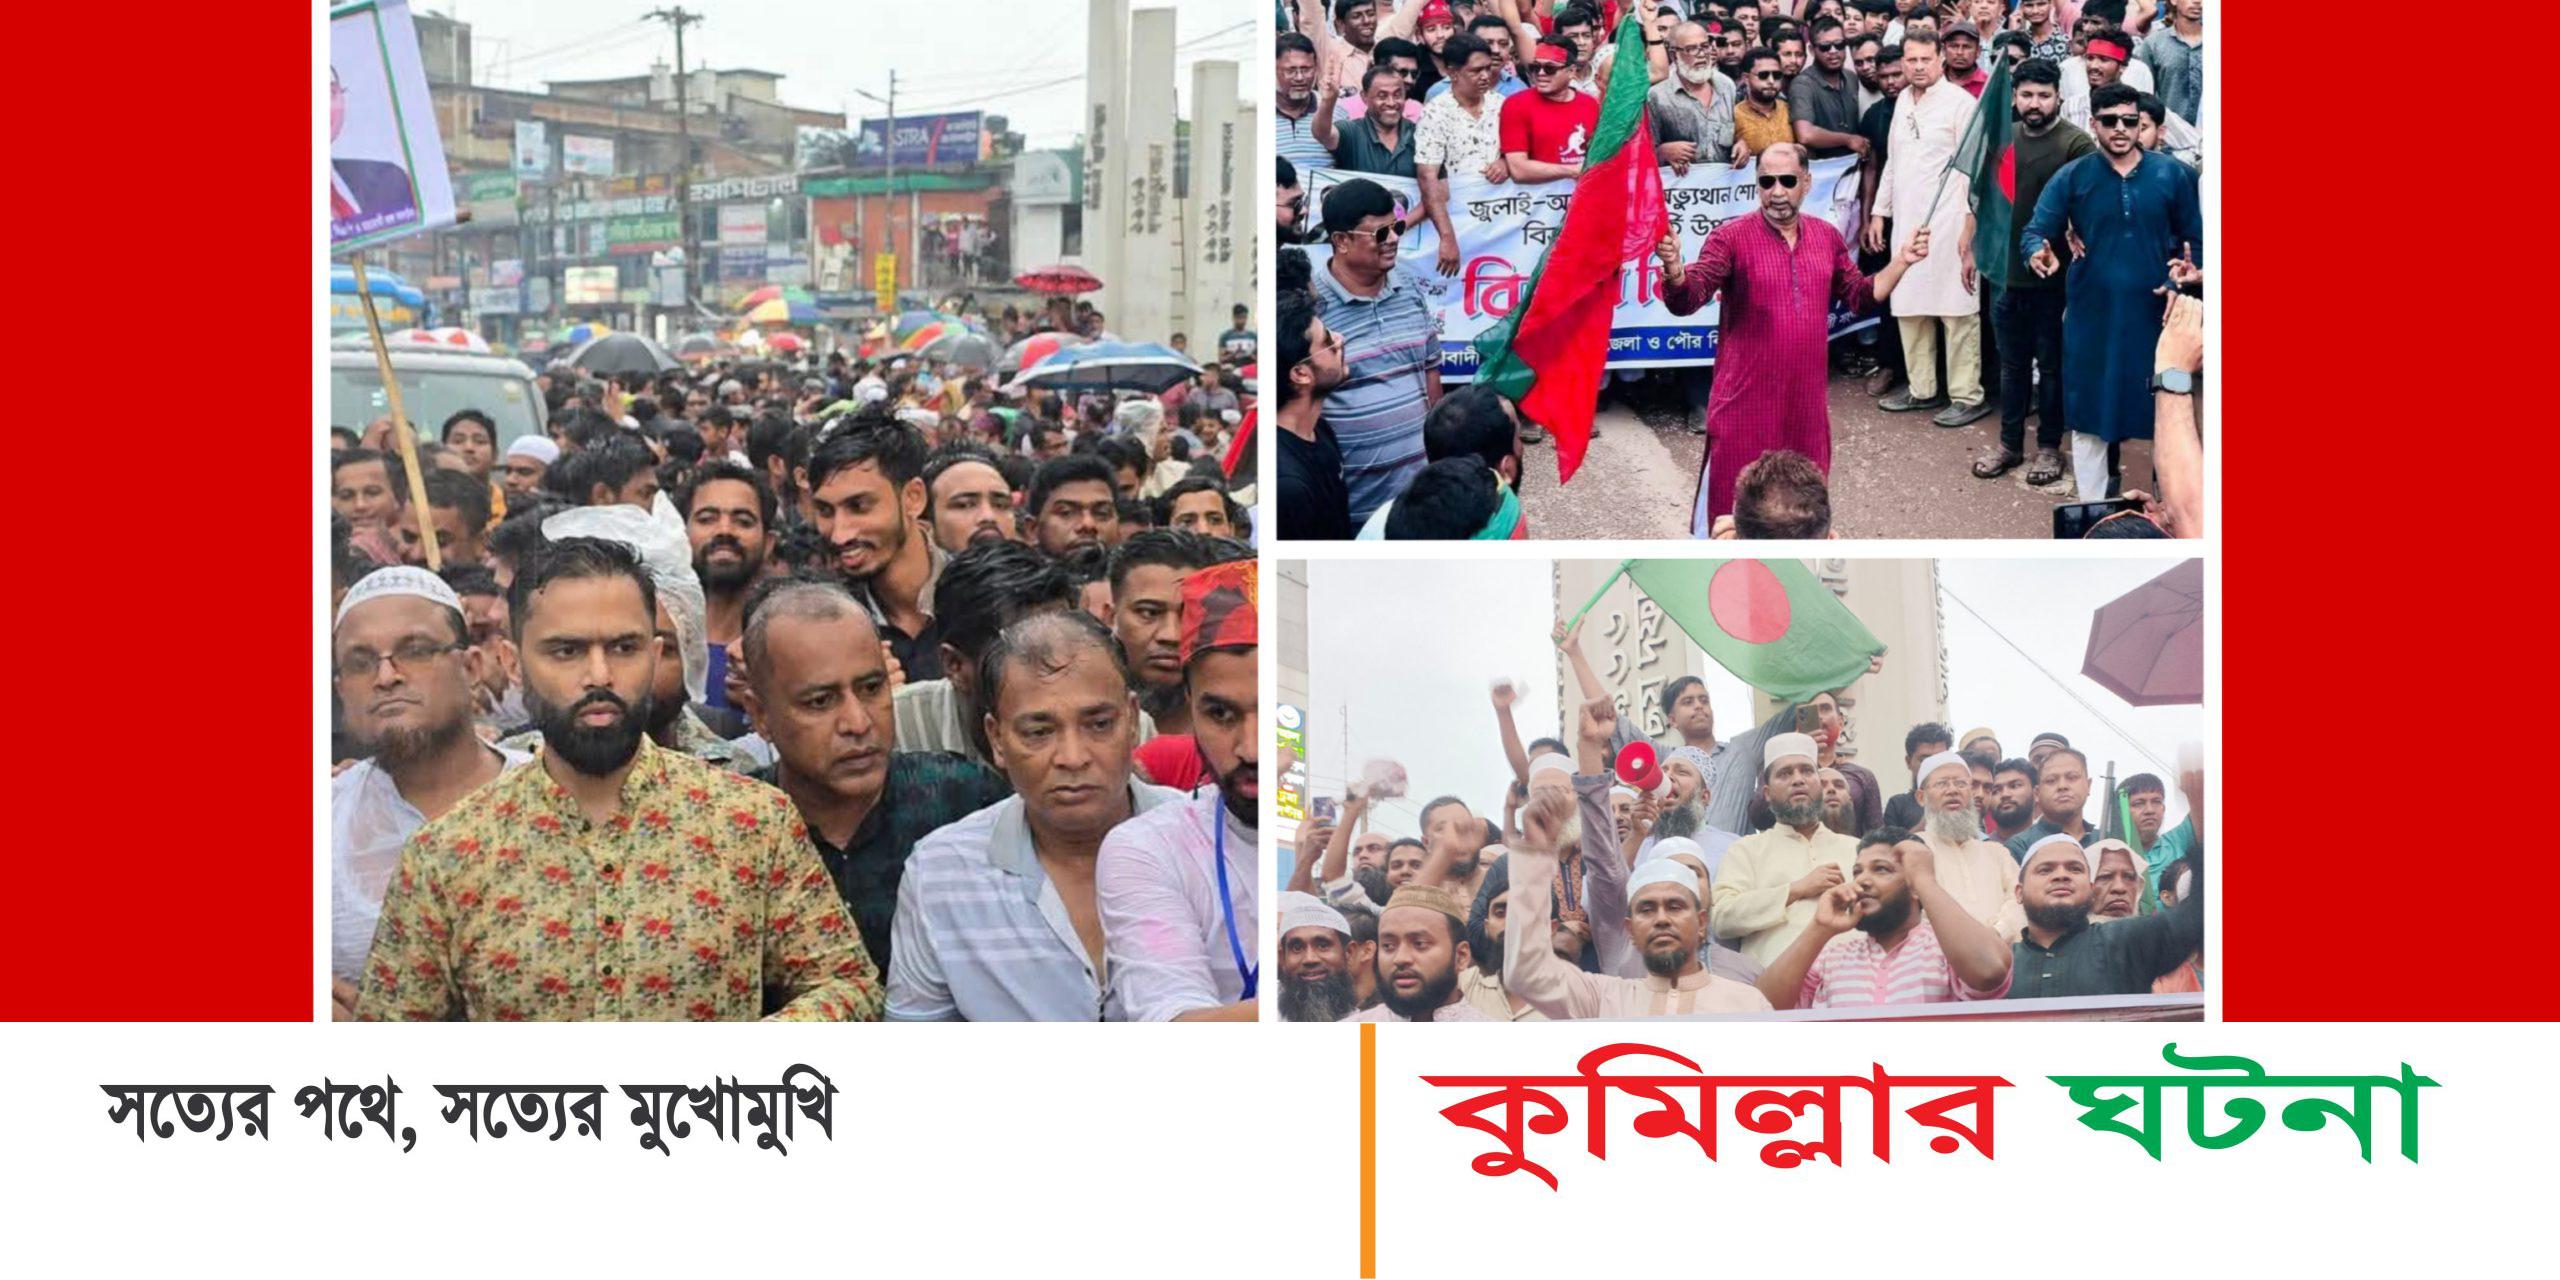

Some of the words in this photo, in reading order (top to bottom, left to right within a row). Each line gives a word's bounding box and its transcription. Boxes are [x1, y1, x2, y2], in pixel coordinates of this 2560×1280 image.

[890, 127, 930, 147] STRA
[1734, 184, 1757, 202] শো
[1461, 254, 1531, 320] বি
[1647, 336, 1661, 350] ও
[1667, 331, 1704, 350] পৌর
